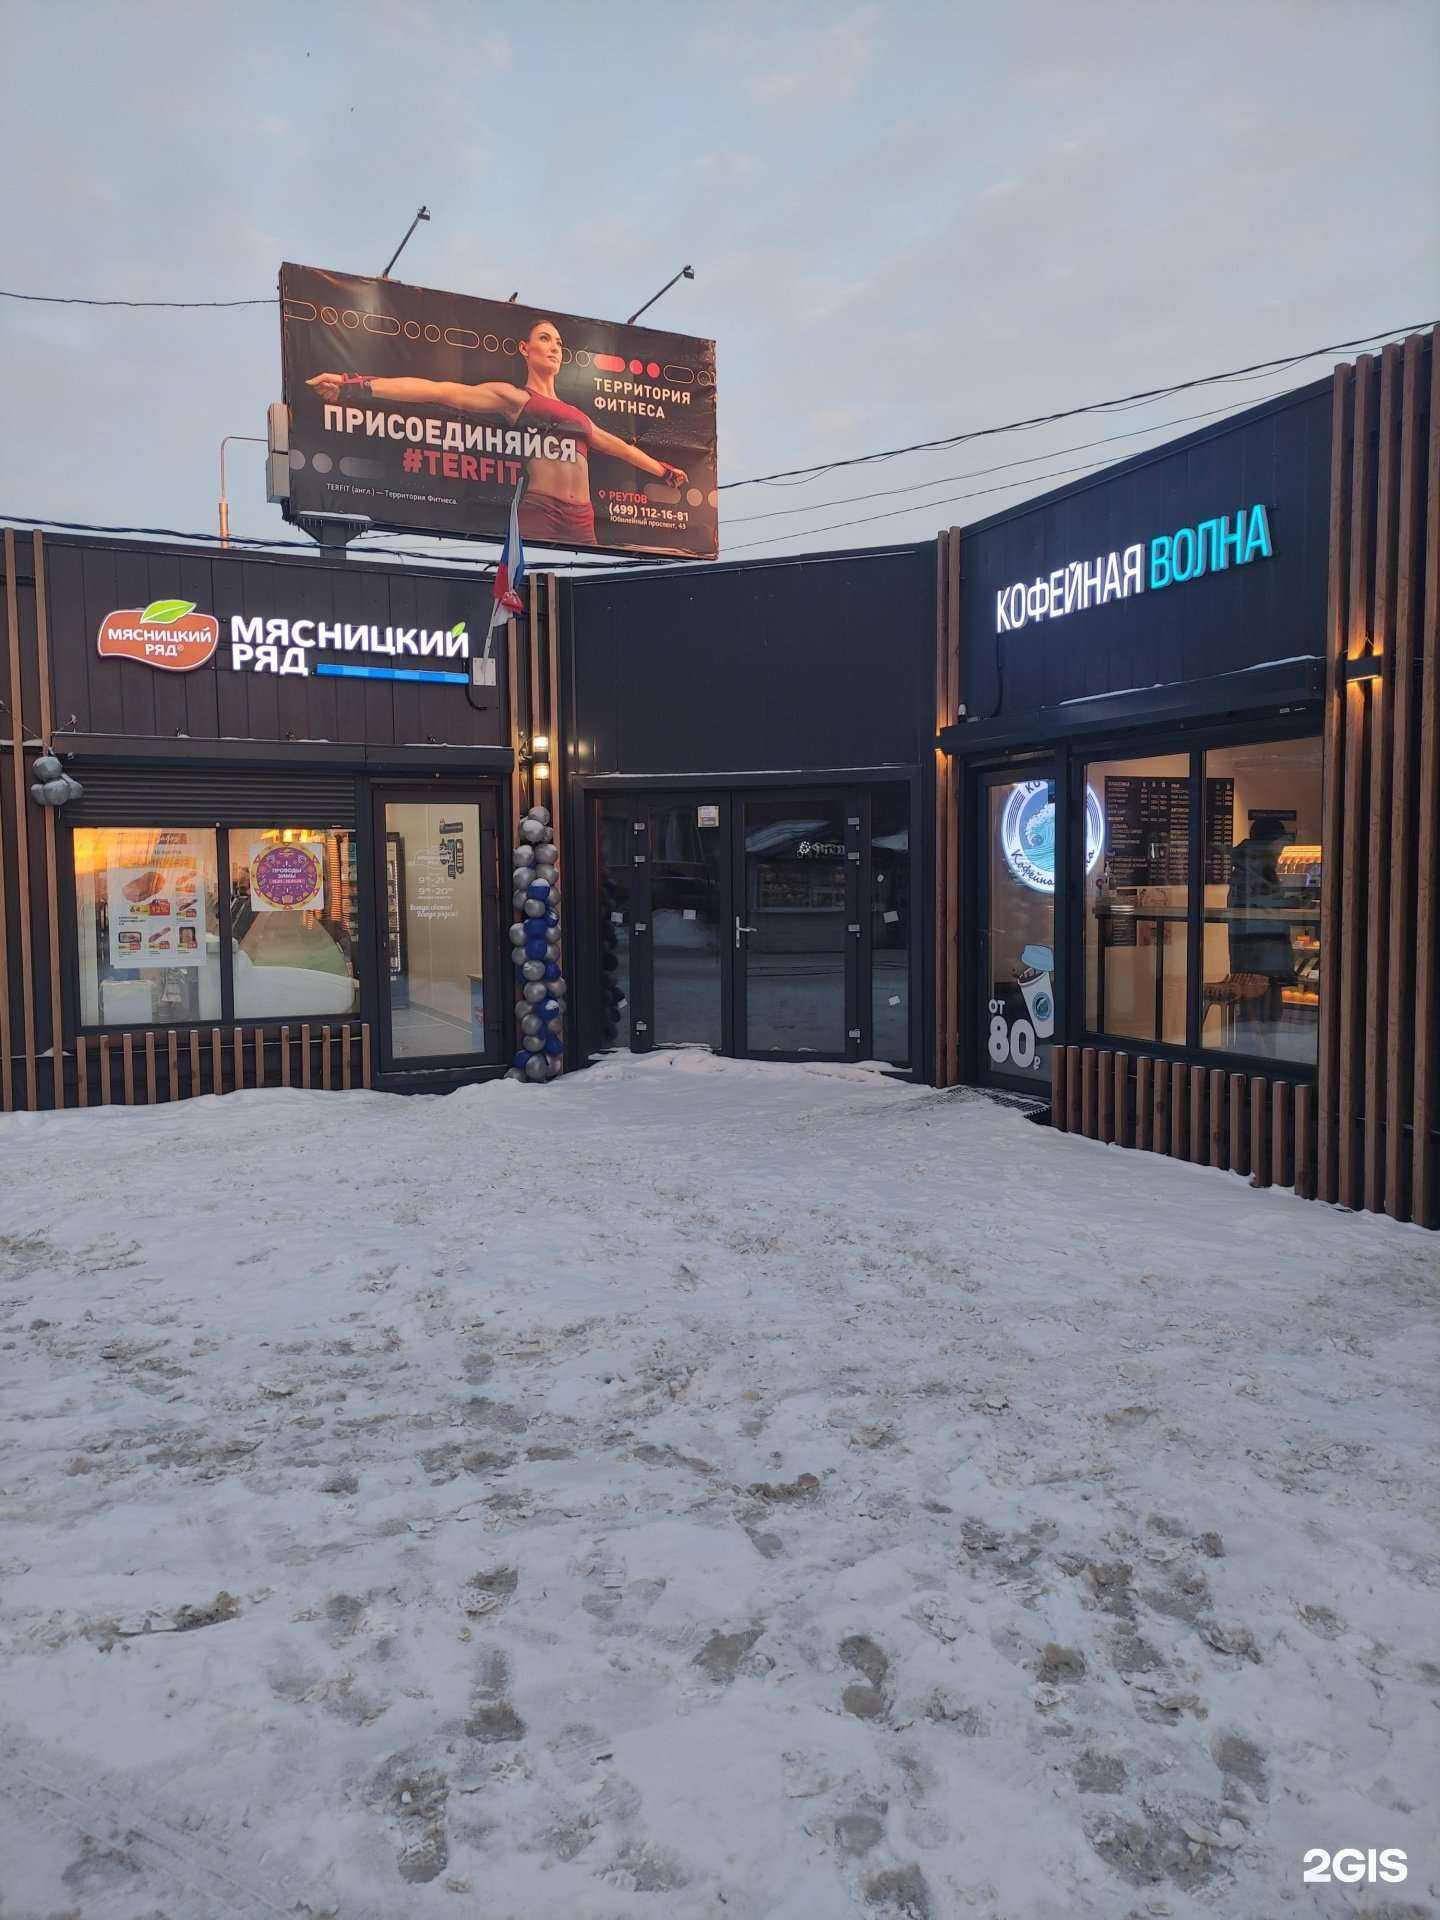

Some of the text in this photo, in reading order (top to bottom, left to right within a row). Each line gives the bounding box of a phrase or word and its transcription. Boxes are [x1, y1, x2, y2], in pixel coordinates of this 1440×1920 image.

[593, 377, 691, 405] ТЕРРИТОРИЯ
[594, 396, 665, 419] ФИТНЕСА
[323, 404, 577, 463] ПРИСОЕДИНЯЙСЯ
[402, 448, 521, 486] #TERFIT
[608, 490, 648, 504] РЕУТОВ
[640, 507, 689, 522] 112-16-81
[996, 503, 1273, 633] КОФЕЙНАЯ ВОЛНА
[107, 627, 212, 643] МЯСНИЦКИЙ
[230, 615, 470, 658] МЯСНИЦКИЙ
[231, 645, 309, 676] РЯД
[1011, 849, 1055, 886] Кофейна
[988, 999, 1006, 1015] ОТ
